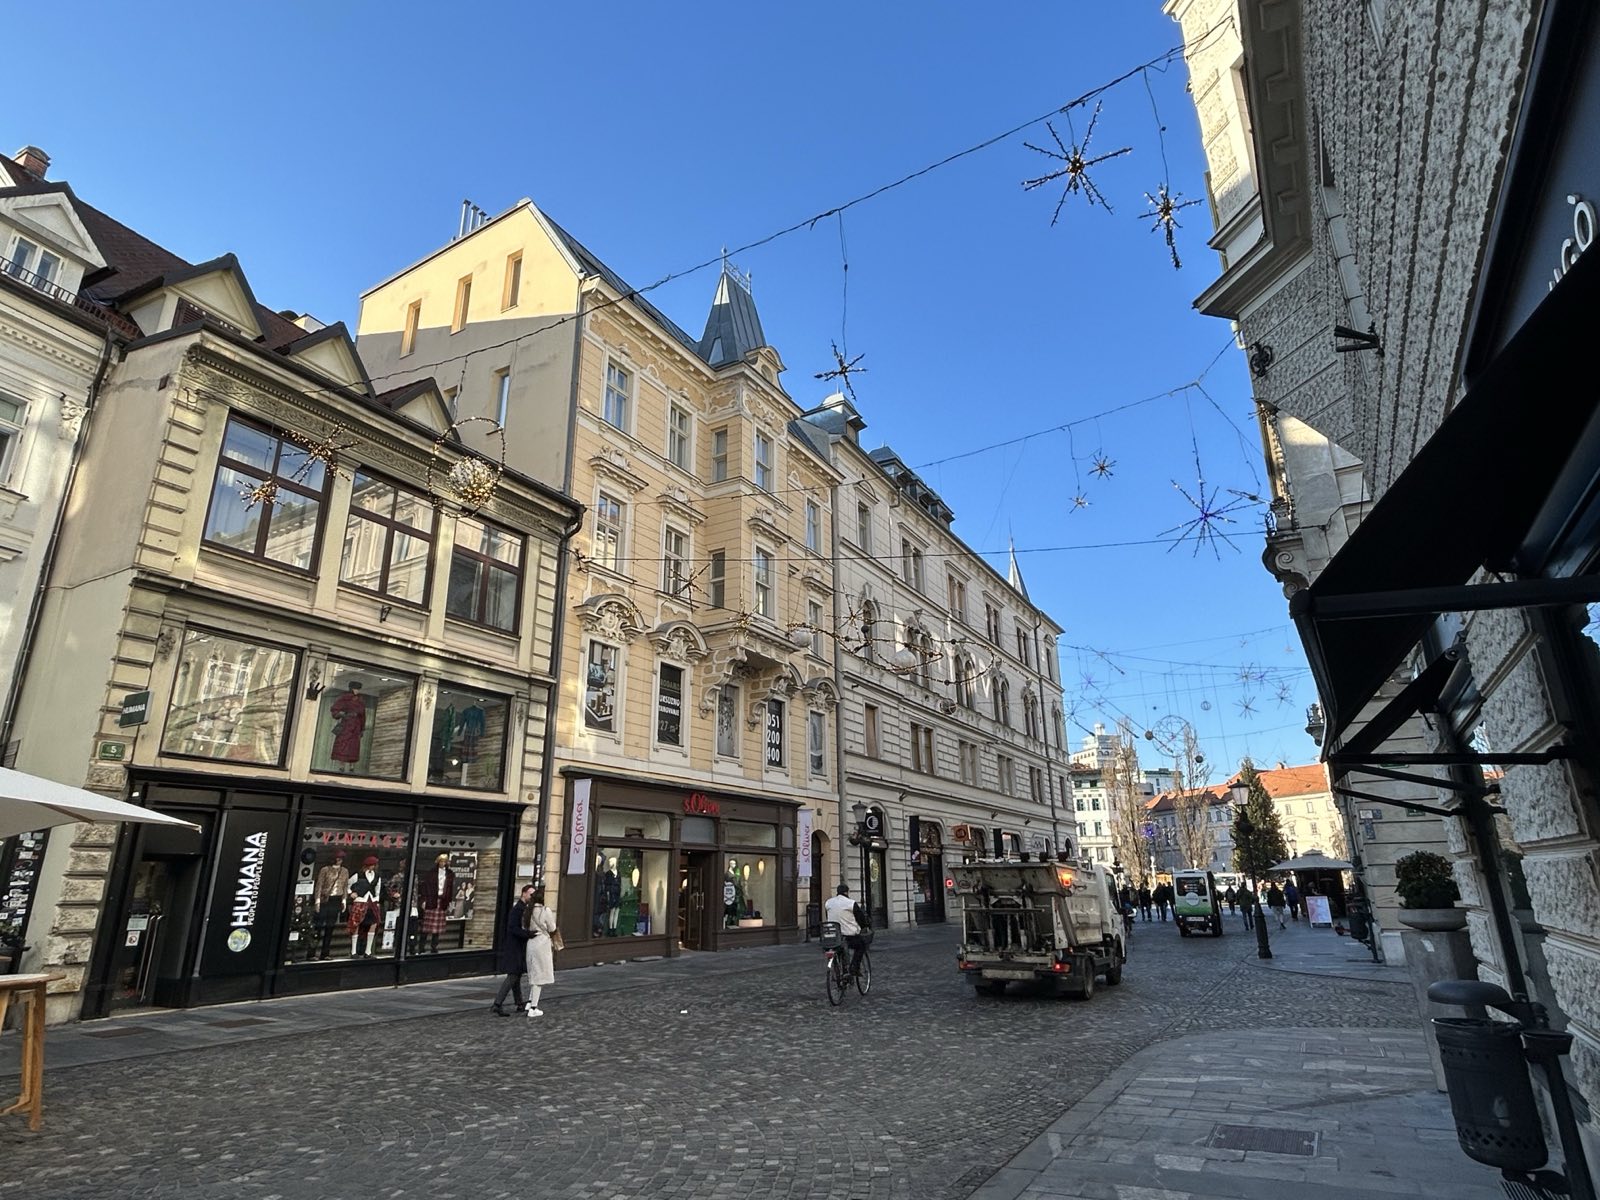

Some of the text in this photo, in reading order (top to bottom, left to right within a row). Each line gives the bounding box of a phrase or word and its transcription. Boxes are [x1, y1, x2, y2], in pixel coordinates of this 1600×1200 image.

[122, 703, 146, 713] HUMANA
[767, 713, 780, 728] 051
[767, 729, 780, 745] 200
[110, 745, 118, 754] 5
[322, 831, 406, 849] VINTAGE
[230, 831, 262, 927] HUMANA
[253, 865, 263, 890] PEOPLE
[252, 890, 259, 900] TO
[247, 900, 257, 926] PEOPLE
